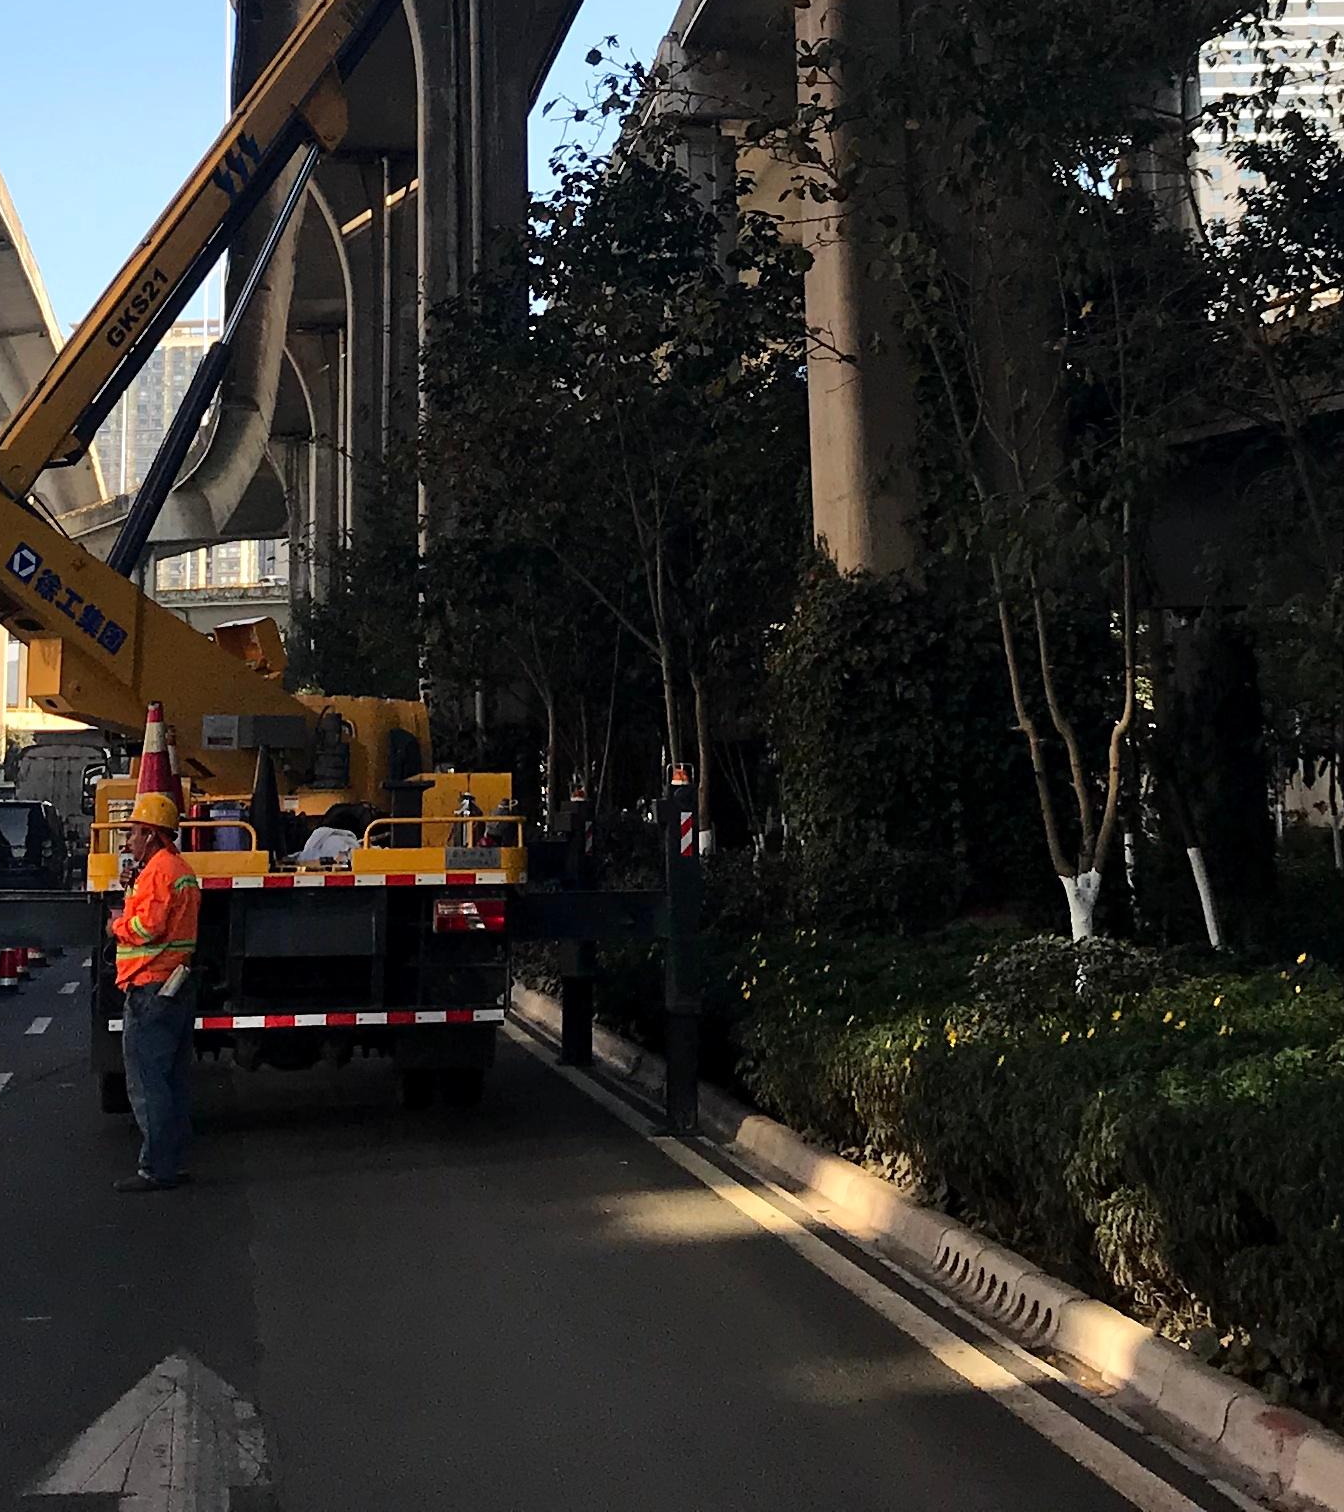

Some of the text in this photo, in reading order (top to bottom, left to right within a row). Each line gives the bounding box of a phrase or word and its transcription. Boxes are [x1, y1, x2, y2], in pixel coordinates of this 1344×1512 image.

[106, 267, 168, 349] GKS21
[33, 568, 128, 656] 徐工集团
